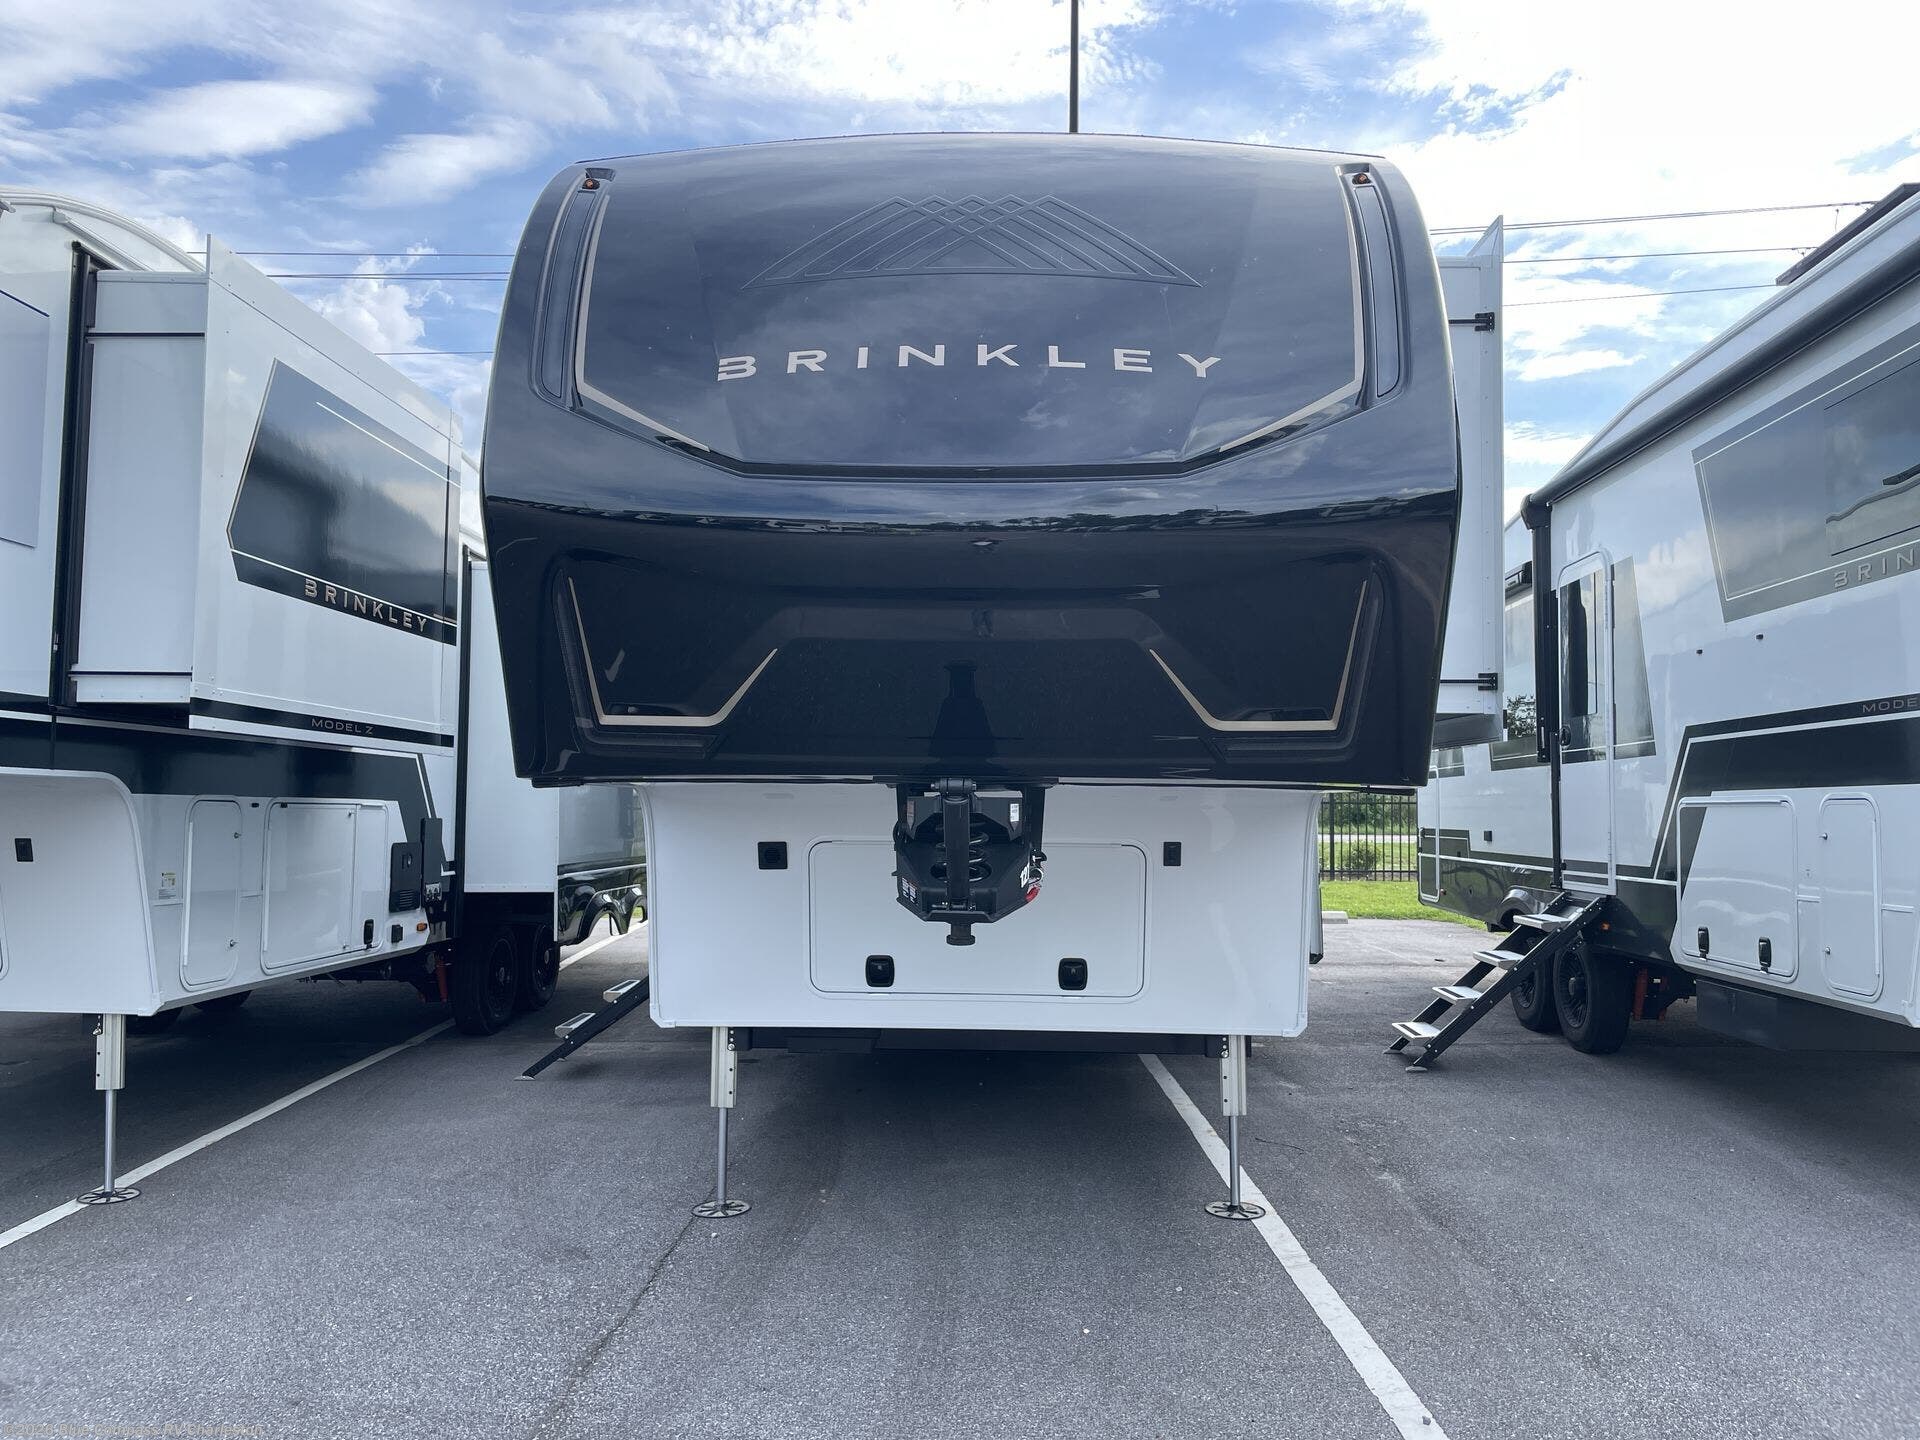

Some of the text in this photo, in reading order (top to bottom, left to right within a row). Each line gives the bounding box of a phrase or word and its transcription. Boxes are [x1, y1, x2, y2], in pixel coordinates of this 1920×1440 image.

[717, 344, 1222, 381] BRINKLEY
[304, 578, 427, 633] BRINKLEY
[311, 718, 375, 735] MODEL Z
